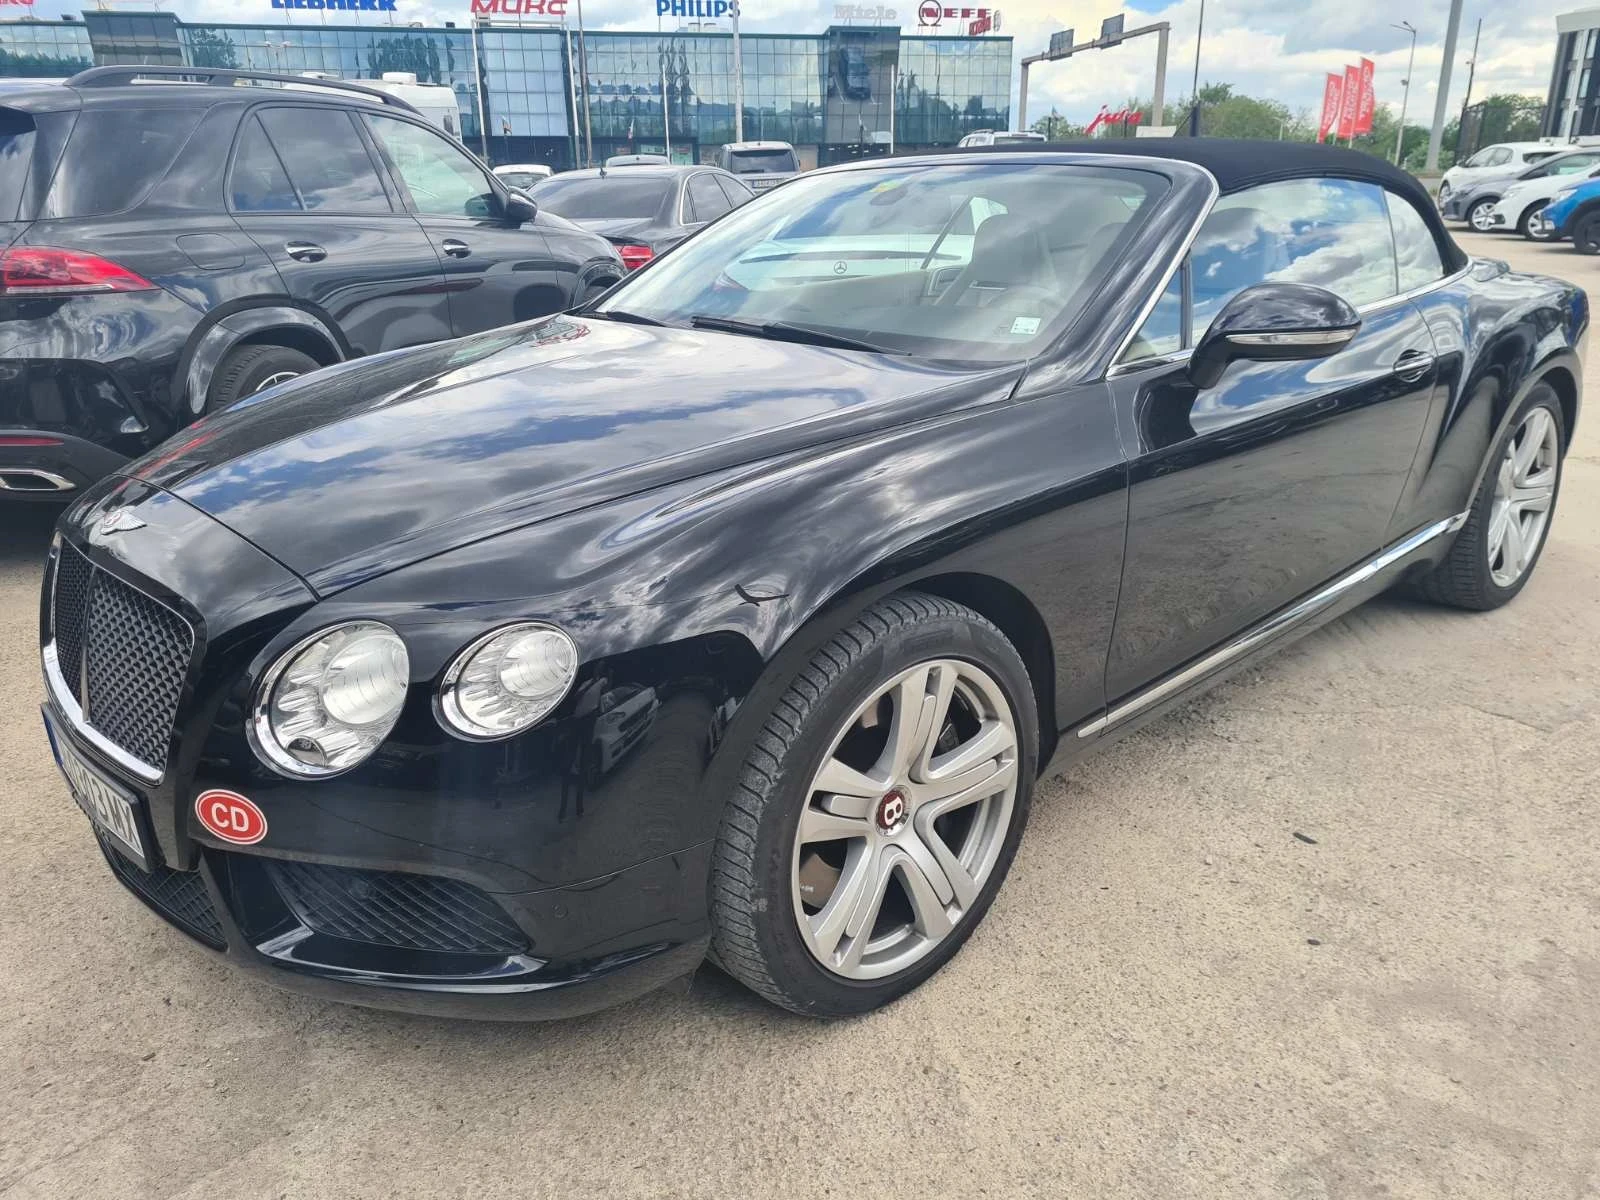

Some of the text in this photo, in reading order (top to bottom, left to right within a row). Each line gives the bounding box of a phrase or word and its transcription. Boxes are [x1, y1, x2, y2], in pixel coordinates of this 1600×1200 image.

[656, 0, 740, 18] PHILIPS
[833, 4, 897, 20] Miele
[919, 5, 991, 19] NEFF
[211, 802, 249, 832] CD
